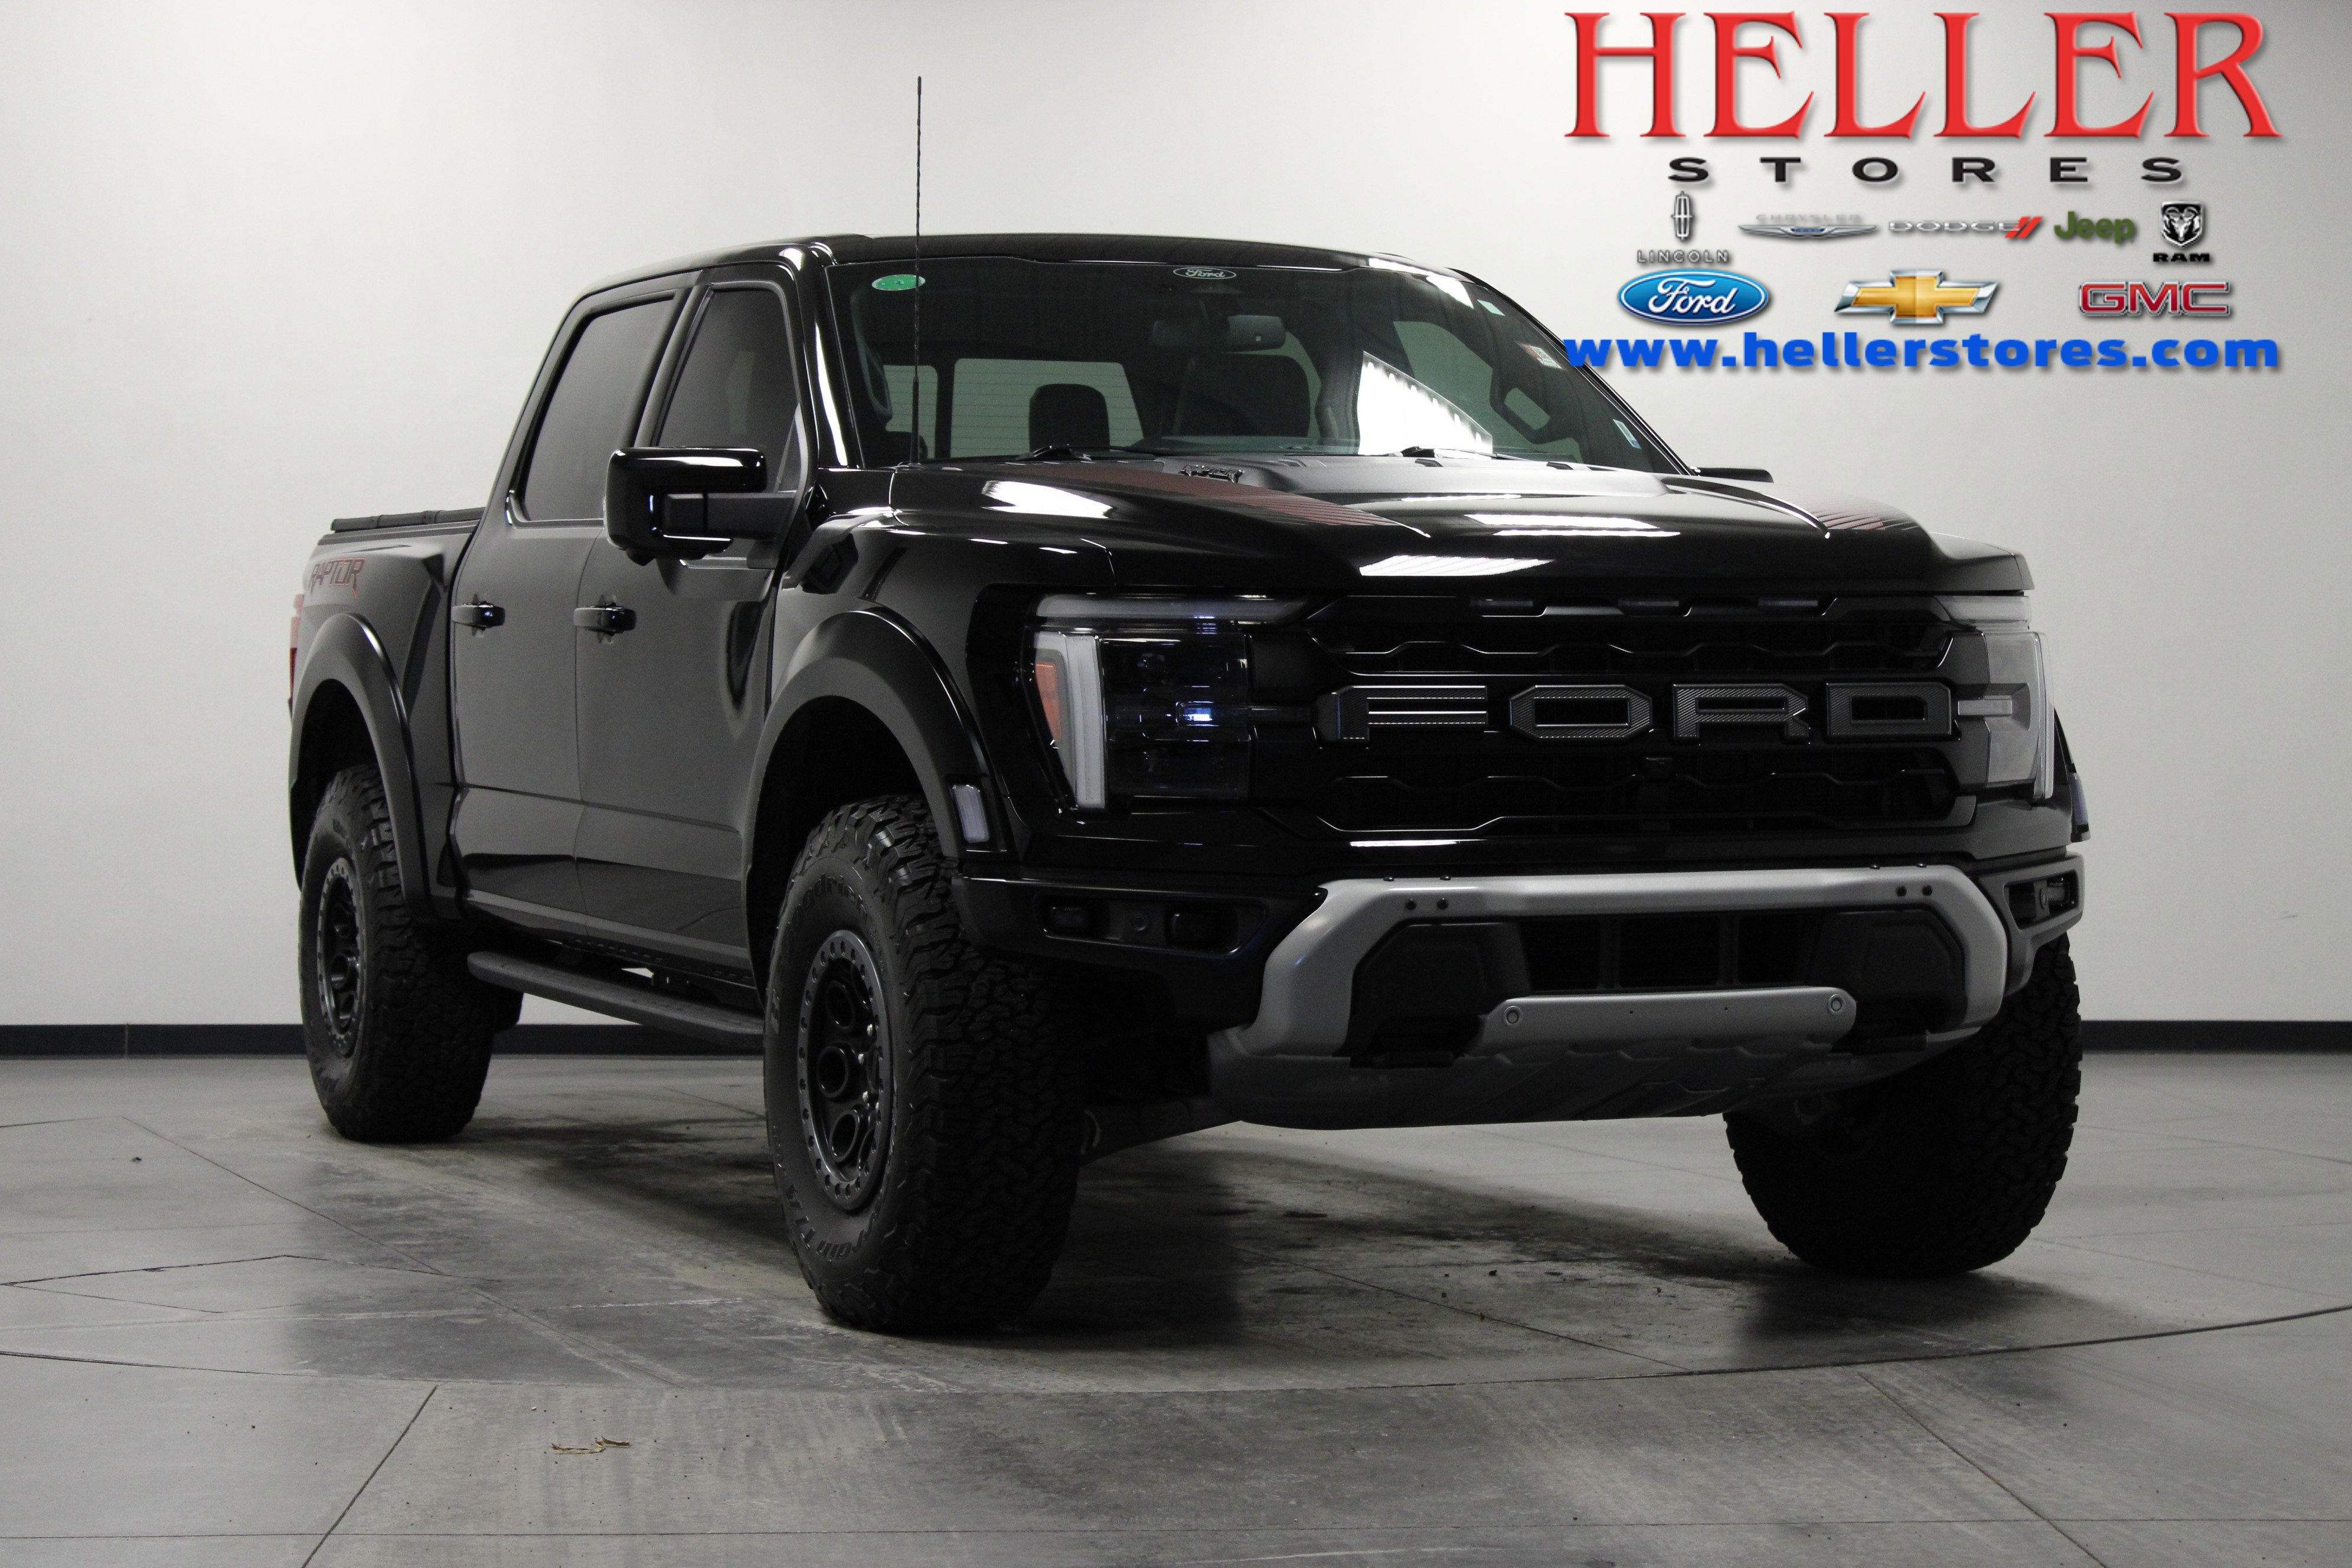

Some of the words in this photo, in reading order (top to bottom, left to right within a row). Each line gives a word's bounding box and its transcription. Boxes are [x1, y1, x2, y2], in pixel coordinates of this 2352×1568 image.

[1185, 268, 1226, 278] Ford
[308, 557, 366, 599] RAPTOR
[1314, 684, 1955, 746] FORD
